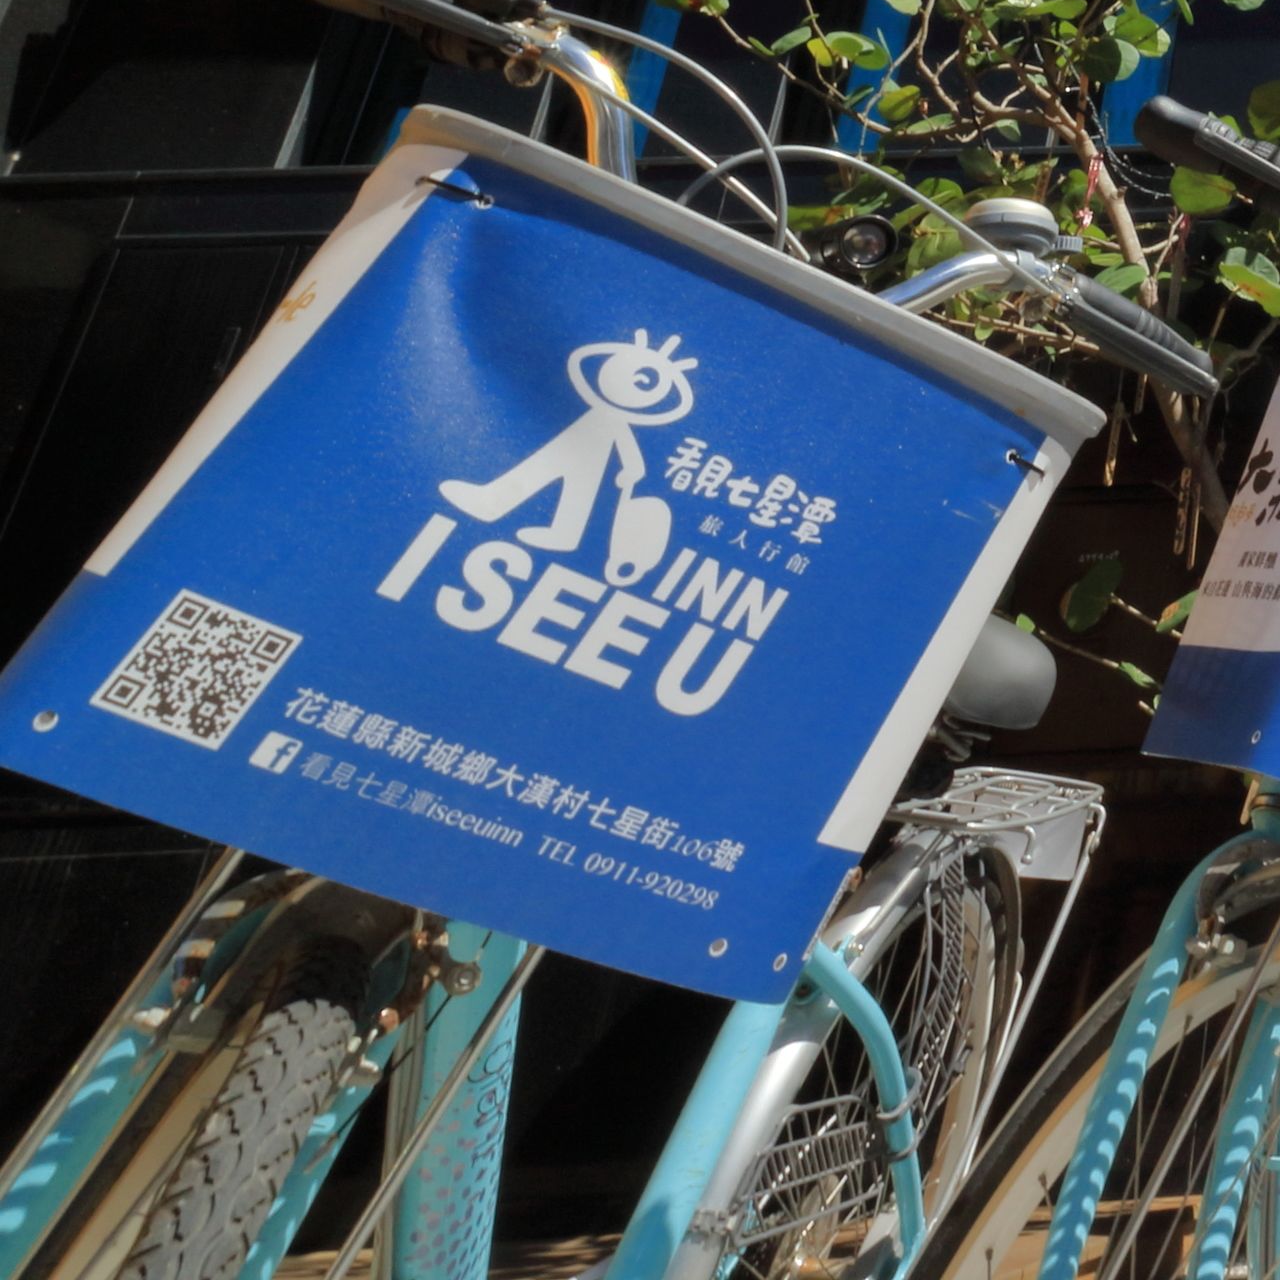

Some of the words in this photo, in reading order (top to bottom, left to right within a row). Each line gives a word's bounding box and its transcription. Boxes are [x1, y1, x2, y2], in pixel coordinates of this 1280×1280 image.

[375, 513, 459, 603] I
[435, 540, 672, 691] SEE
[655, 622, 756, 717] U
[651, 547, 790, 641] INN
[536, 835, 576, 867] TEL
[584, 852, 721, 911] 0911-920298
